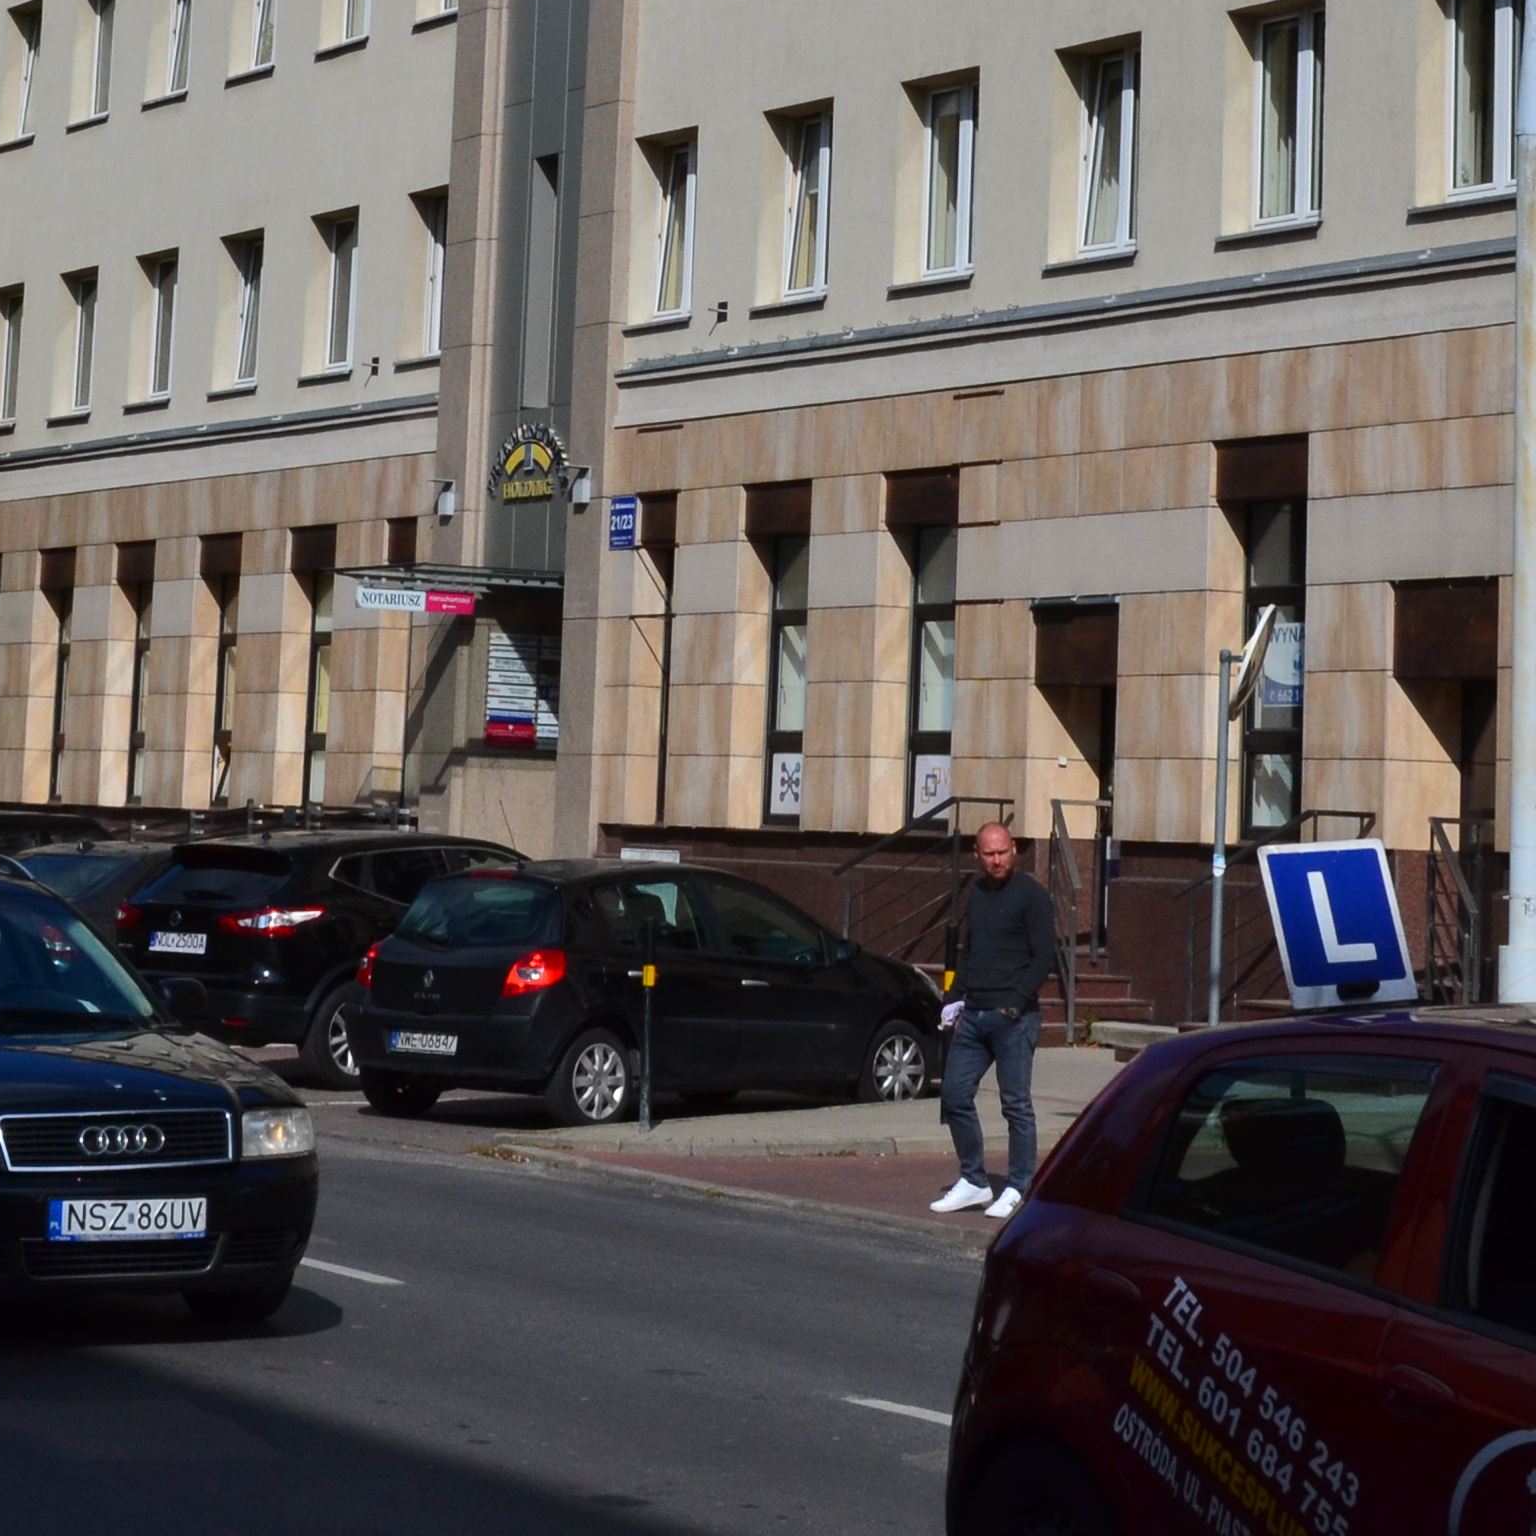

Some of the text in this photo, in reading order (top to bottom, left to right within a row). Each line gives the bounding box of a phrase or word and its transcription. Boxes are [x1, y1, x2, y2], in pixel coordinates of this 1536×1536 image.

[503, 480, 553, 500] HOLDING
[610, 514, 633, 531] 21/23
[361, 591, 421, 607] NOTARIUSZ
[1306, 871, 1378, 964] L
[67, 1200, 204, 1232] NSZ 86UV
[1163, 1275, 1360, 1508] TEL. 504 546 243
[1146, 1312, 1350, 1536] TEL. 601 684 755
[1113, 1402, 1180, 1498] OSTRÓDA,
[1182, 1469, 1204, 1518] UL.
